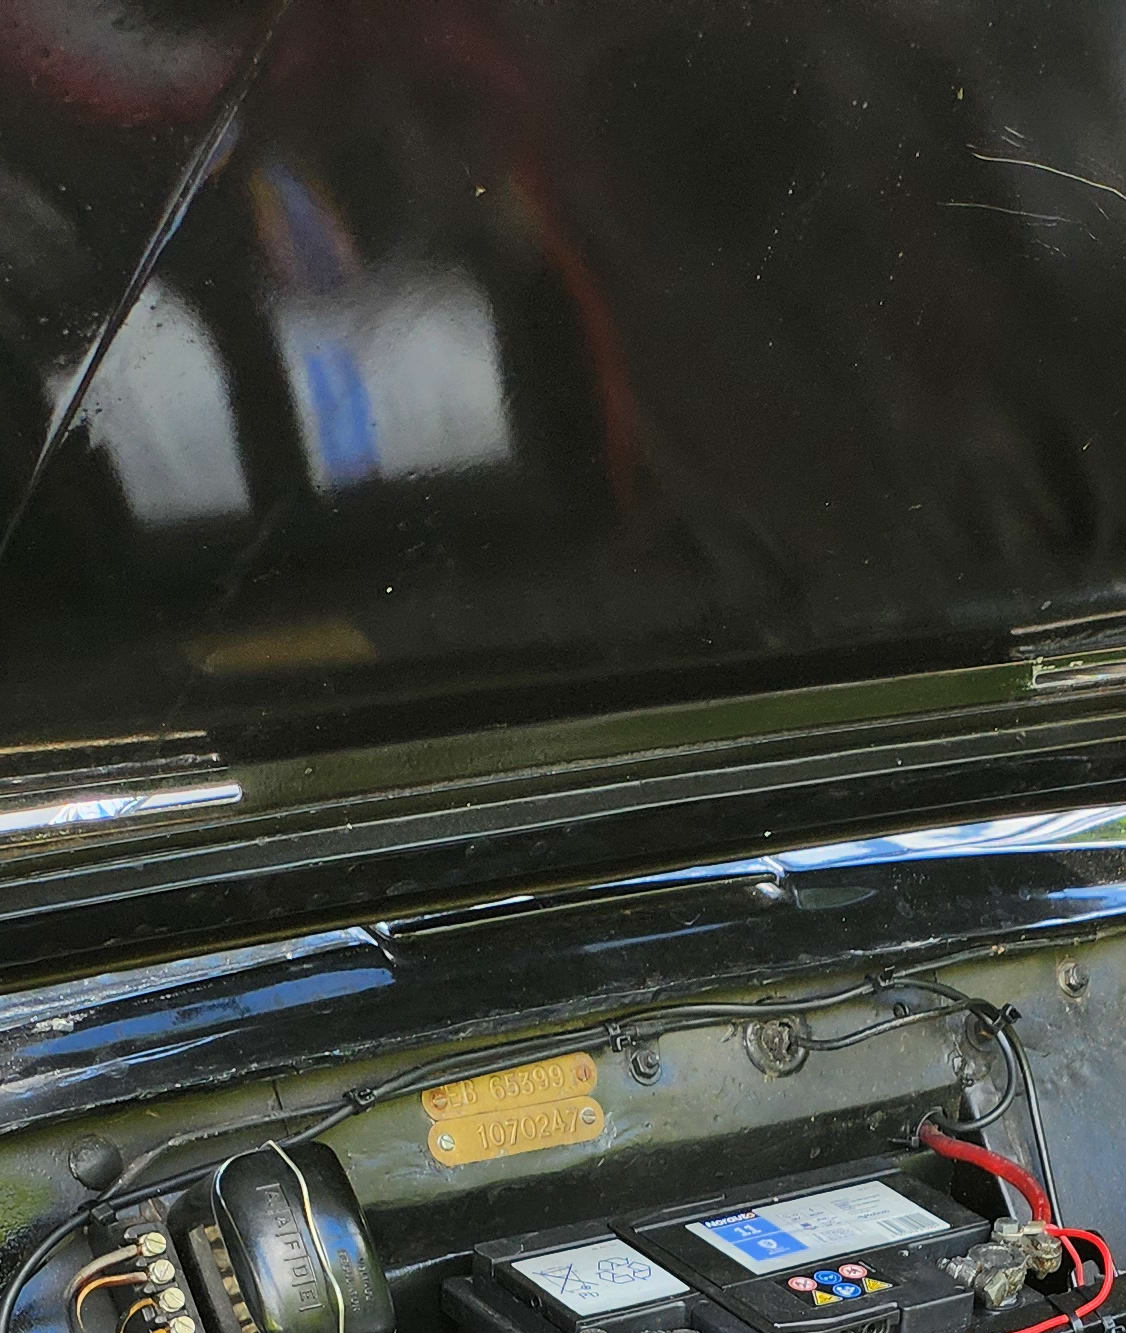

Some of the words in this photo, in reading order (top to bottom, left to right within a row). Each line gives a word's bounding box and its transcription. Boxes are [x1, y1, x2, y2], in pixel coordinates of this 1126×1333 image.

[489, 1064, 564, 1099] 65399
[476, 1108, 580, 1150] 1070247
[705, 1212, 756, 1228] Norauto
[734, 1224, 762, 1238] 11
